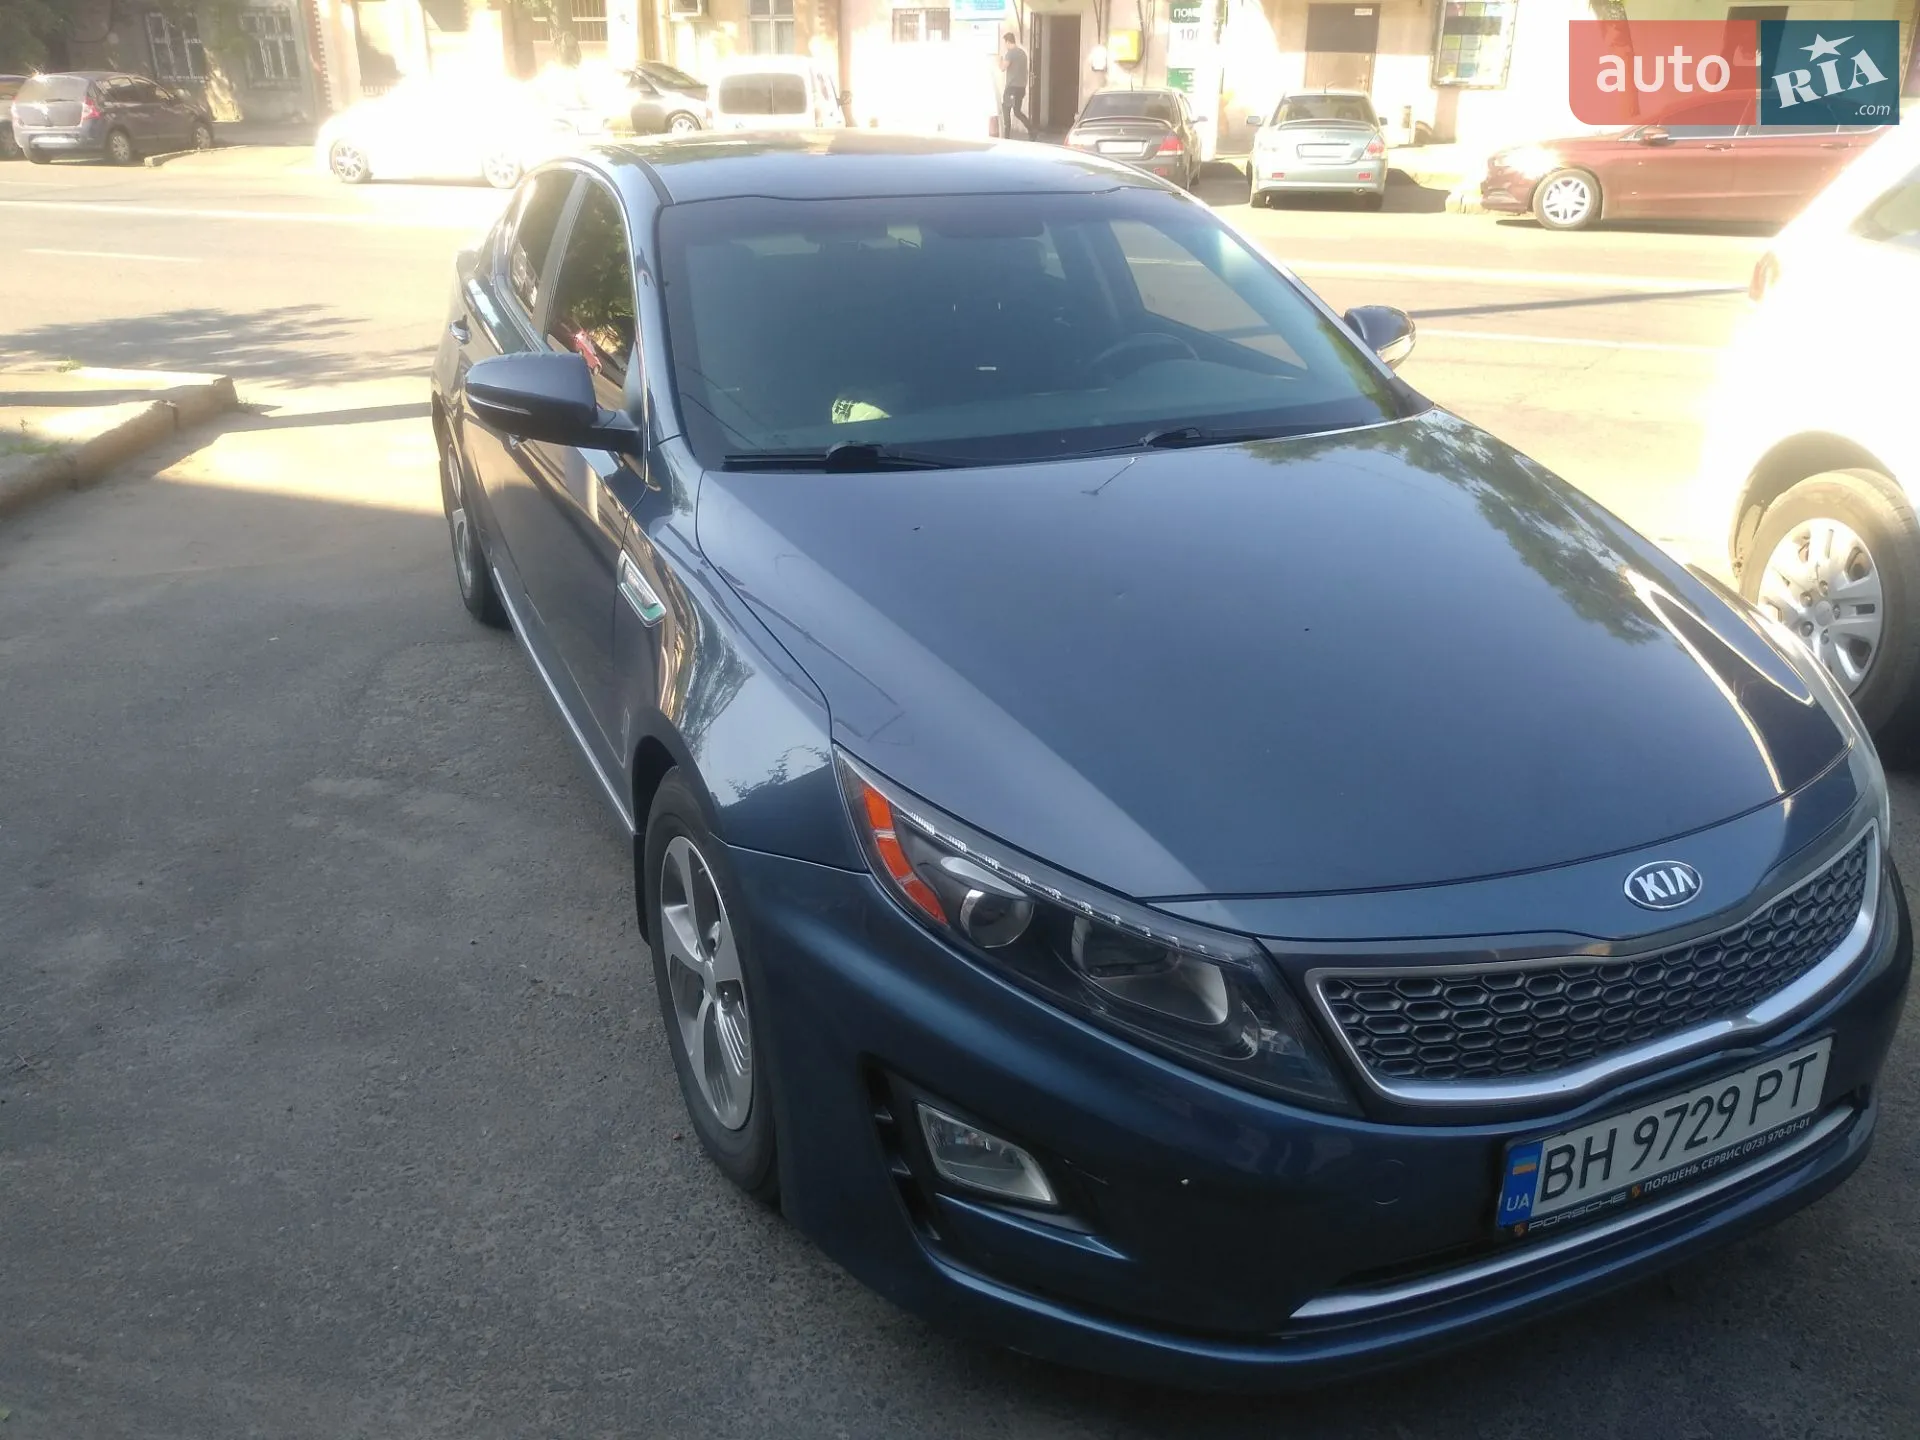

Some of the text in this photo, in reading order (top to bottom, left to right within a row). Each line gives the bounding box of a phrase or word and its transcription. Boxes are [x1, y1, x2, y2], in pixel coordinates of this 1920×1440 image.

[1635, 867, 1697, 901] KIA
[1540, 1052, 1818, 1202] BH 9729 PT
[1645, 1117, 1811, 1191] ПОРШЕНЬ СЕРВИС (073) 970-01-01
[1506, 1195, 1530, 1212] UA
[1528, 1192, 1627, 1231] PORSCHE
